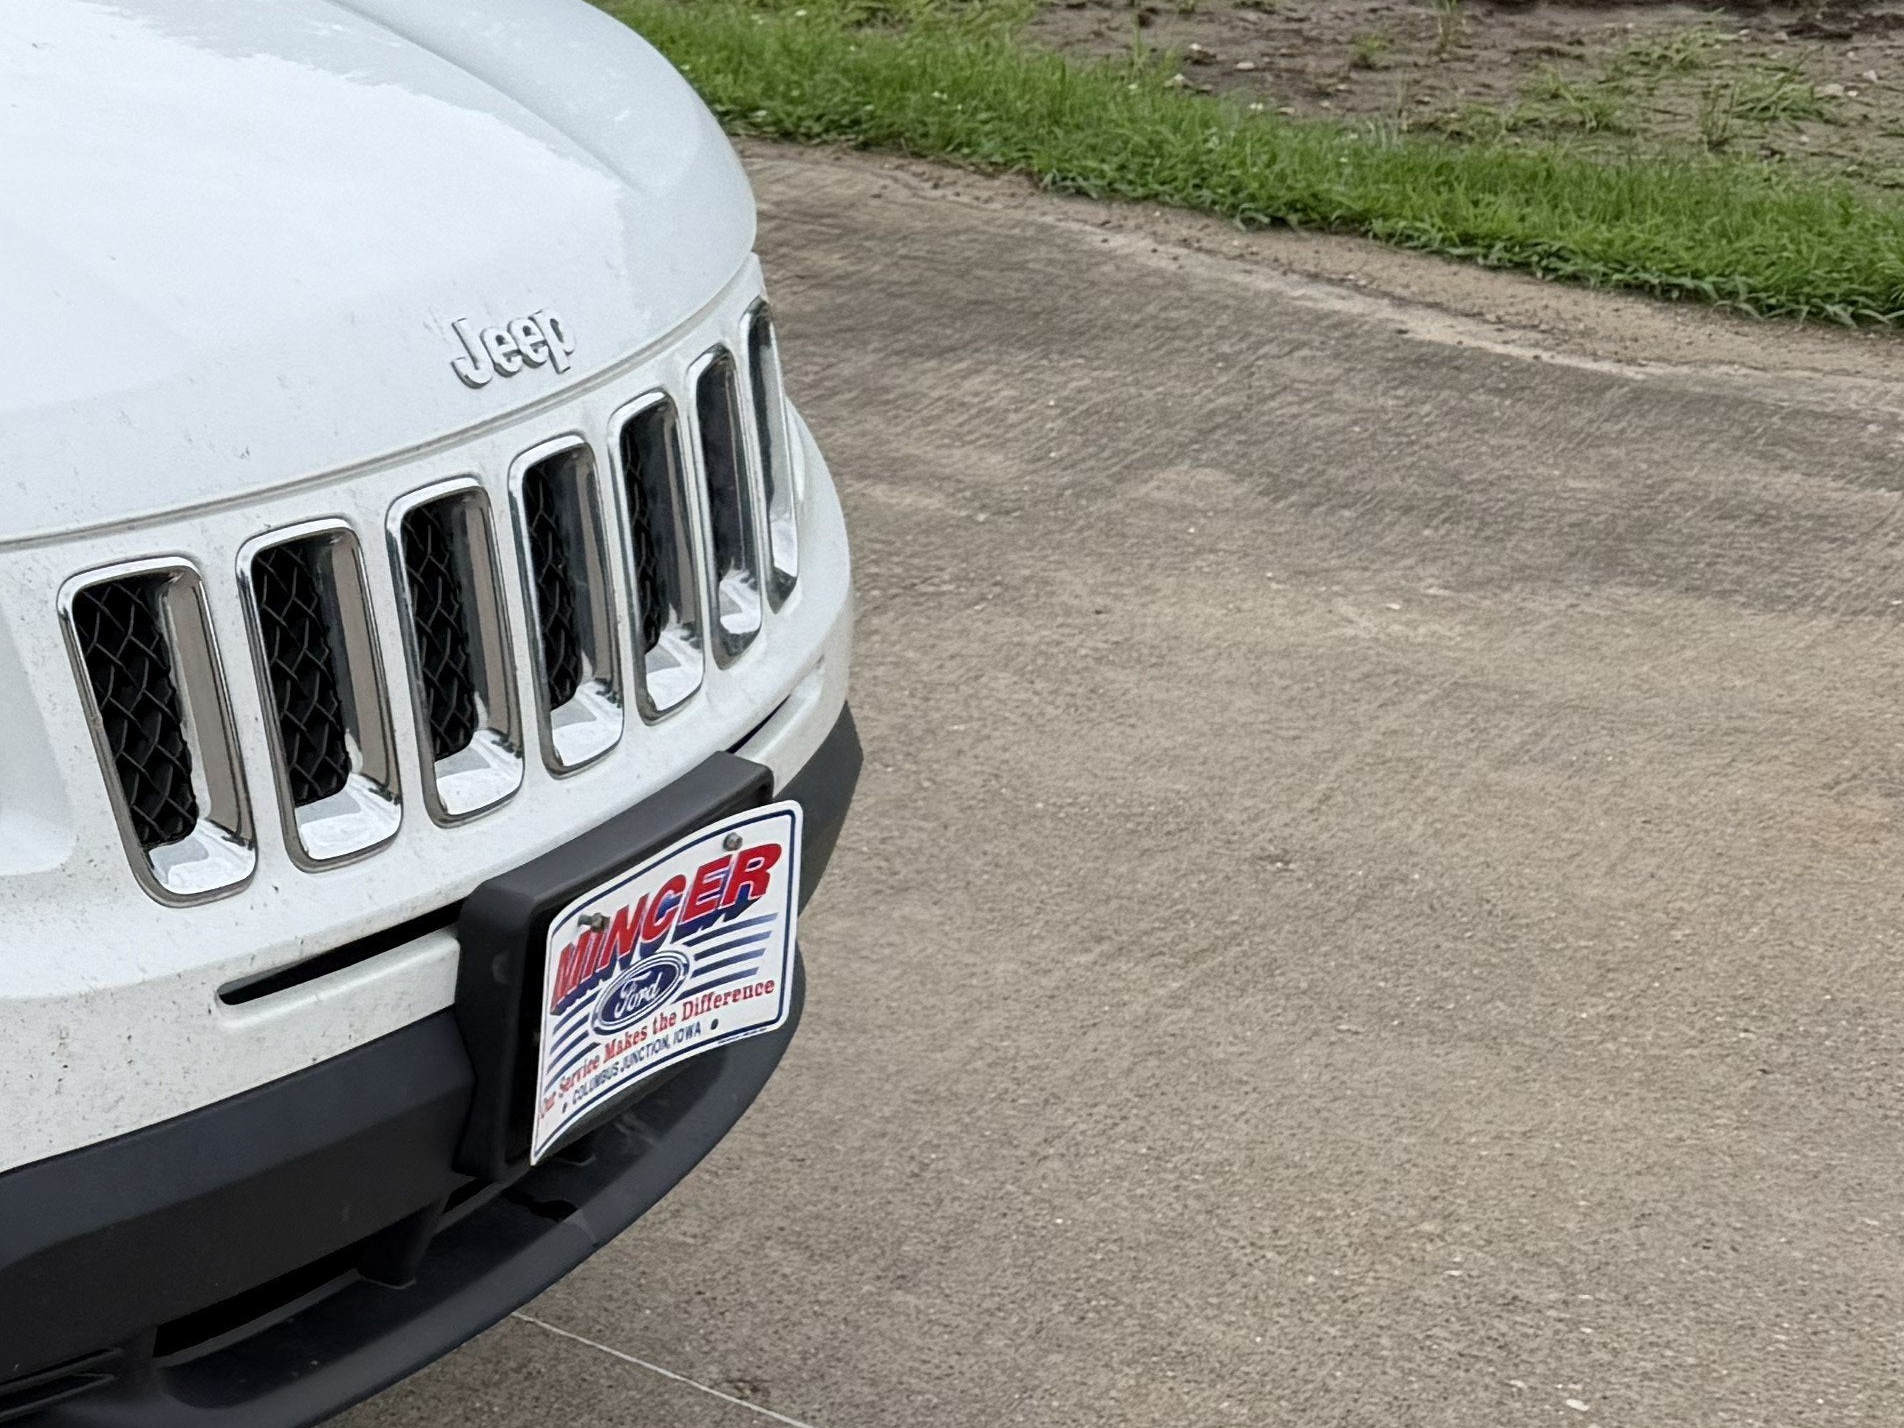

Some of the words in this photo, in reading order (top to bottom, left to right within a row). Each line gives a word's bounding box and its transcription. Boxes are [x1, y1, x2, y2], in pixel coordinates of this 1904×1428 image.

[450, 306, 577, 390] Jeep
[550, 842, 783, 1014] MINCER
[559, 1055, 600, 1093] Service
[603, 1025, 648, 1064] Makes
[652, 1012, 677, 1035] the
[681, 979, 776, 1022] Difference
[613, 970, 664, 1019] Ford
[673, 1021, 702, 1045] IOWA
